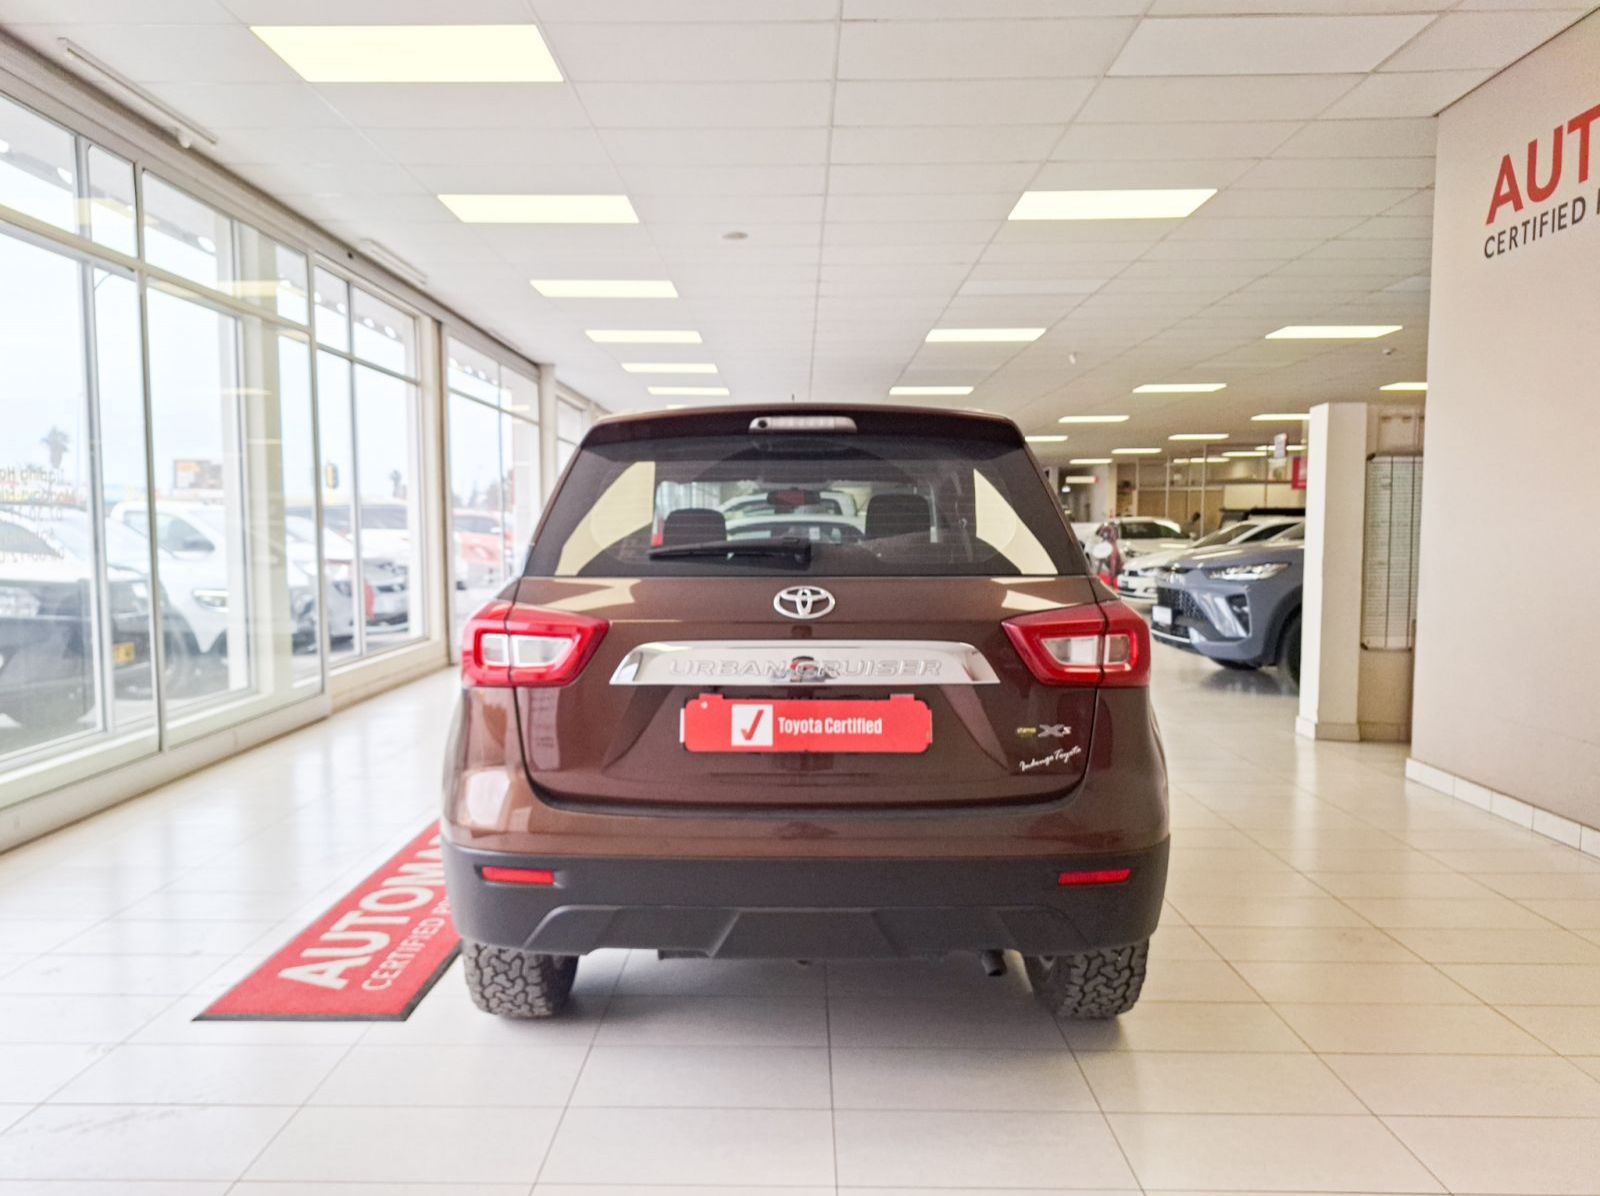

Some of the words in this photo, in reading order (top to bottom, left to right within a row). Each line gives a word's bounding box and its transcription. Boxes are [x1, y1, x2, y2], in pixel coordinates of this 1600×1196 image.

[1485, 103, 1600, 225] AUT
[1483, 195, 1587, 259] CERTIFIED
[670, 657, 789, 677] URBAN
[794, 657, 943, 677] CRUISER
[777, 716, 822, 736] Toyota
[824, 716, 883, 735] Certified
[361, 917, 446, 992] CERTIFIED
